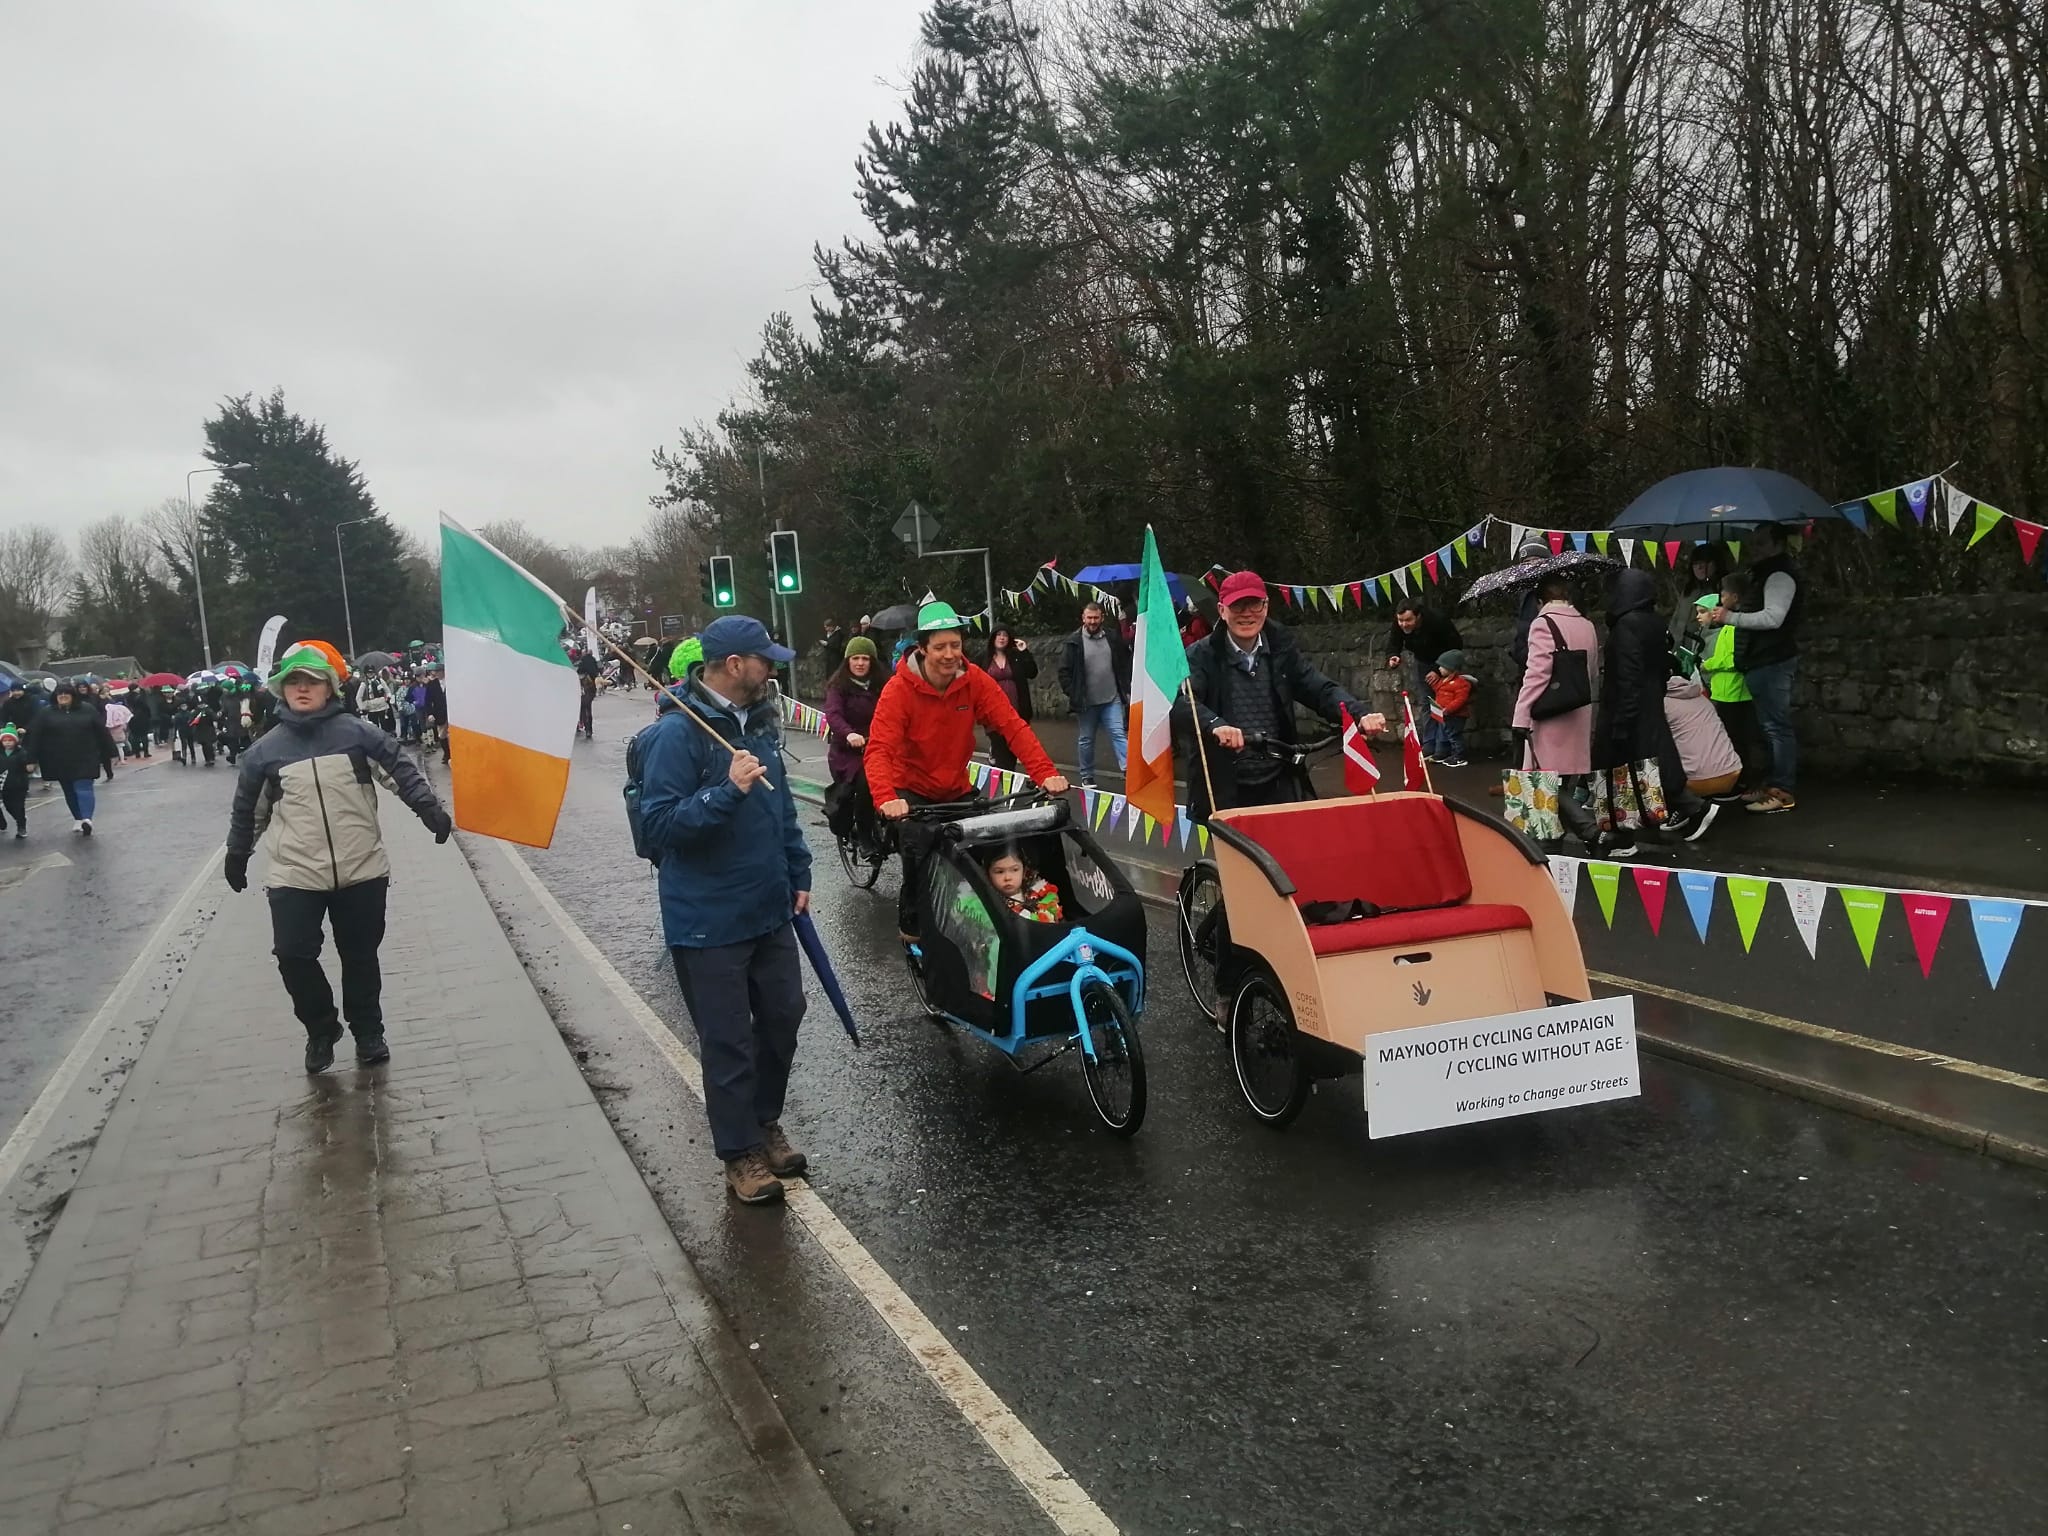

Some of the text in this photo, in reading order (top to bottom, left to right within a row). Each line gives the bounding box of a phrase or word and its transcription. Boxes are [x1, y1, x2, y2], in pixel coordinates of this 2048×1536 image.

[1379, 1014, 1615, 1063] MAYNOOTH CYCLING CAMPAIGN
[1457, 1052, 1518, 1075] CYCLING
[1522, 1041, 1591, 1064] WITHOUT
[1594, 1036, 1623, 1053] AGE
[1456, 1076, 1629, 1112] Working to Change our Streets
